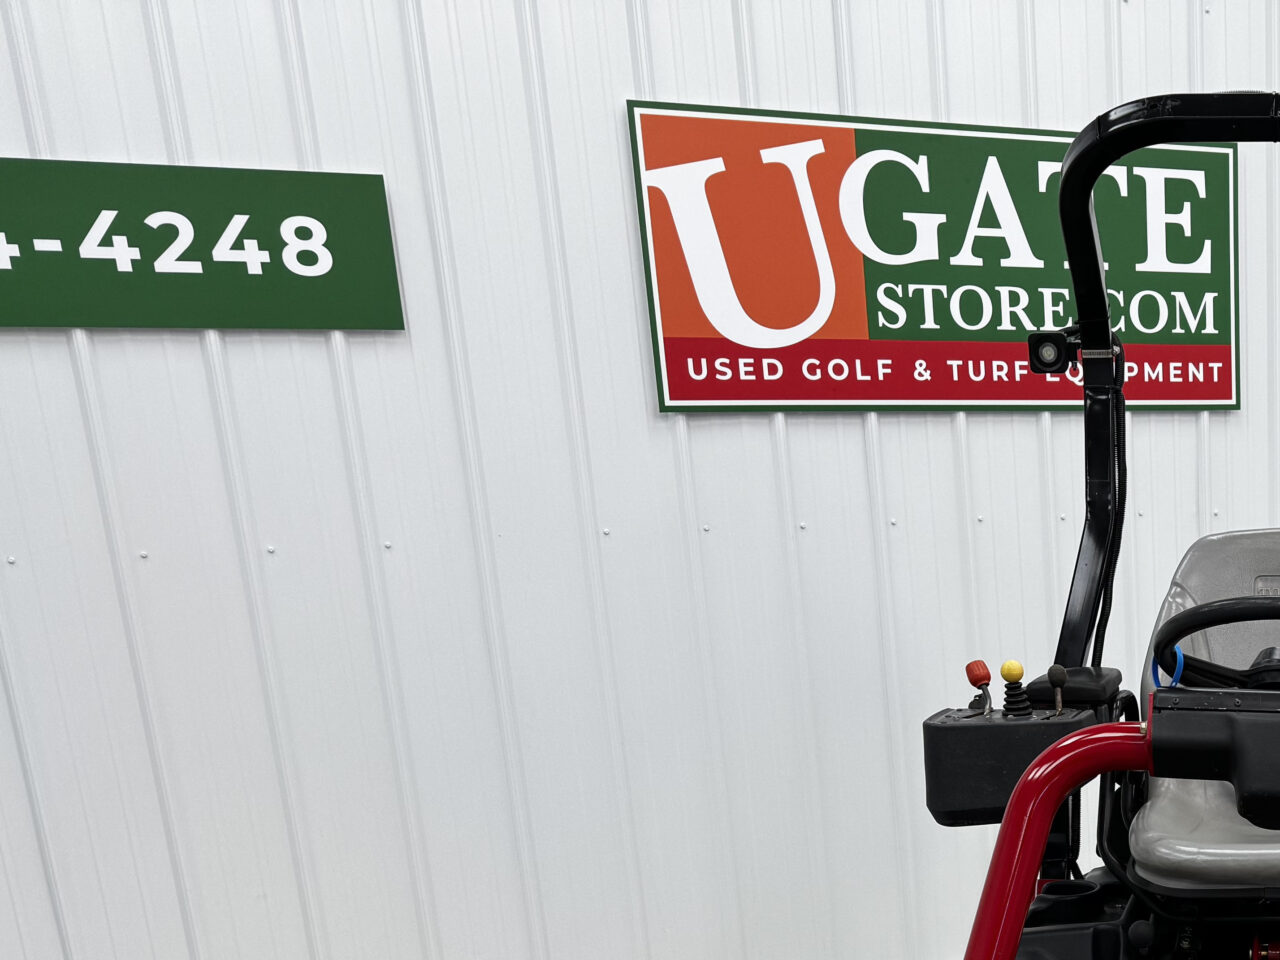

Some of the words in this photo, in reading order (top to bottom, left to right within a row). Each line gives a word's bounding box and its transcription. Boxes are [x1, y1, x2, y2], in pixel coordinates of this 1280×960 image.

[876, 282, 1219, 334] STORECOM
[687, 357, 784, 382] USED
[801, 358, 893, 382] GOLF
[912, 359, 932, 382] &
[946, 359, 1029, 383] TURF
[1045, 361, 1223, 387] QPMENT
